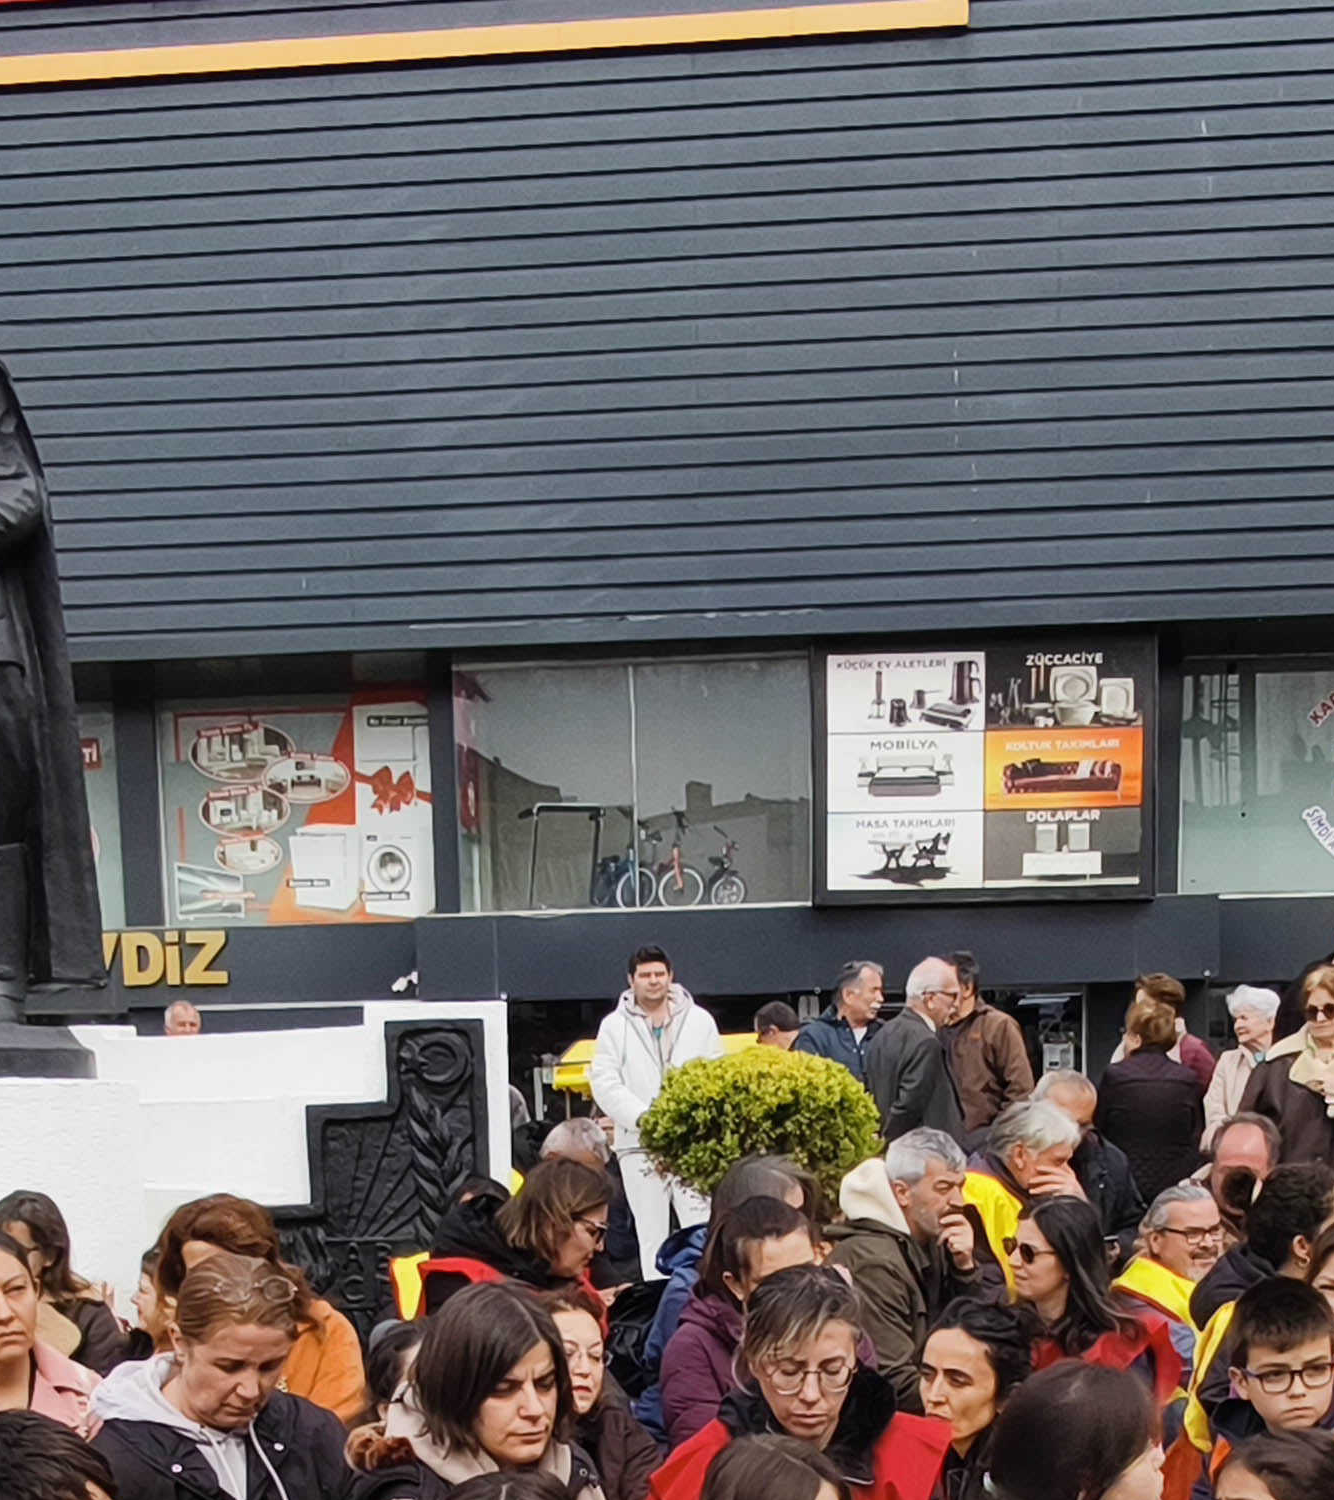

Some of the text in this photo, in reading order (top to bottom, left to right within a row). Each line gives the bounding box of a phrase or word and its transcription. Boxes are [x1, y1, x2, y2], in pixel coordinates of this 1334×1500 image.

[877, 660, 890, 669] EV
[1025, 652, 1103, 666] ZÜCCACİYE
[870, 738, 939, 751] MOBİLYA
[1025, 810, 1101, 822] DOLAPLAR
